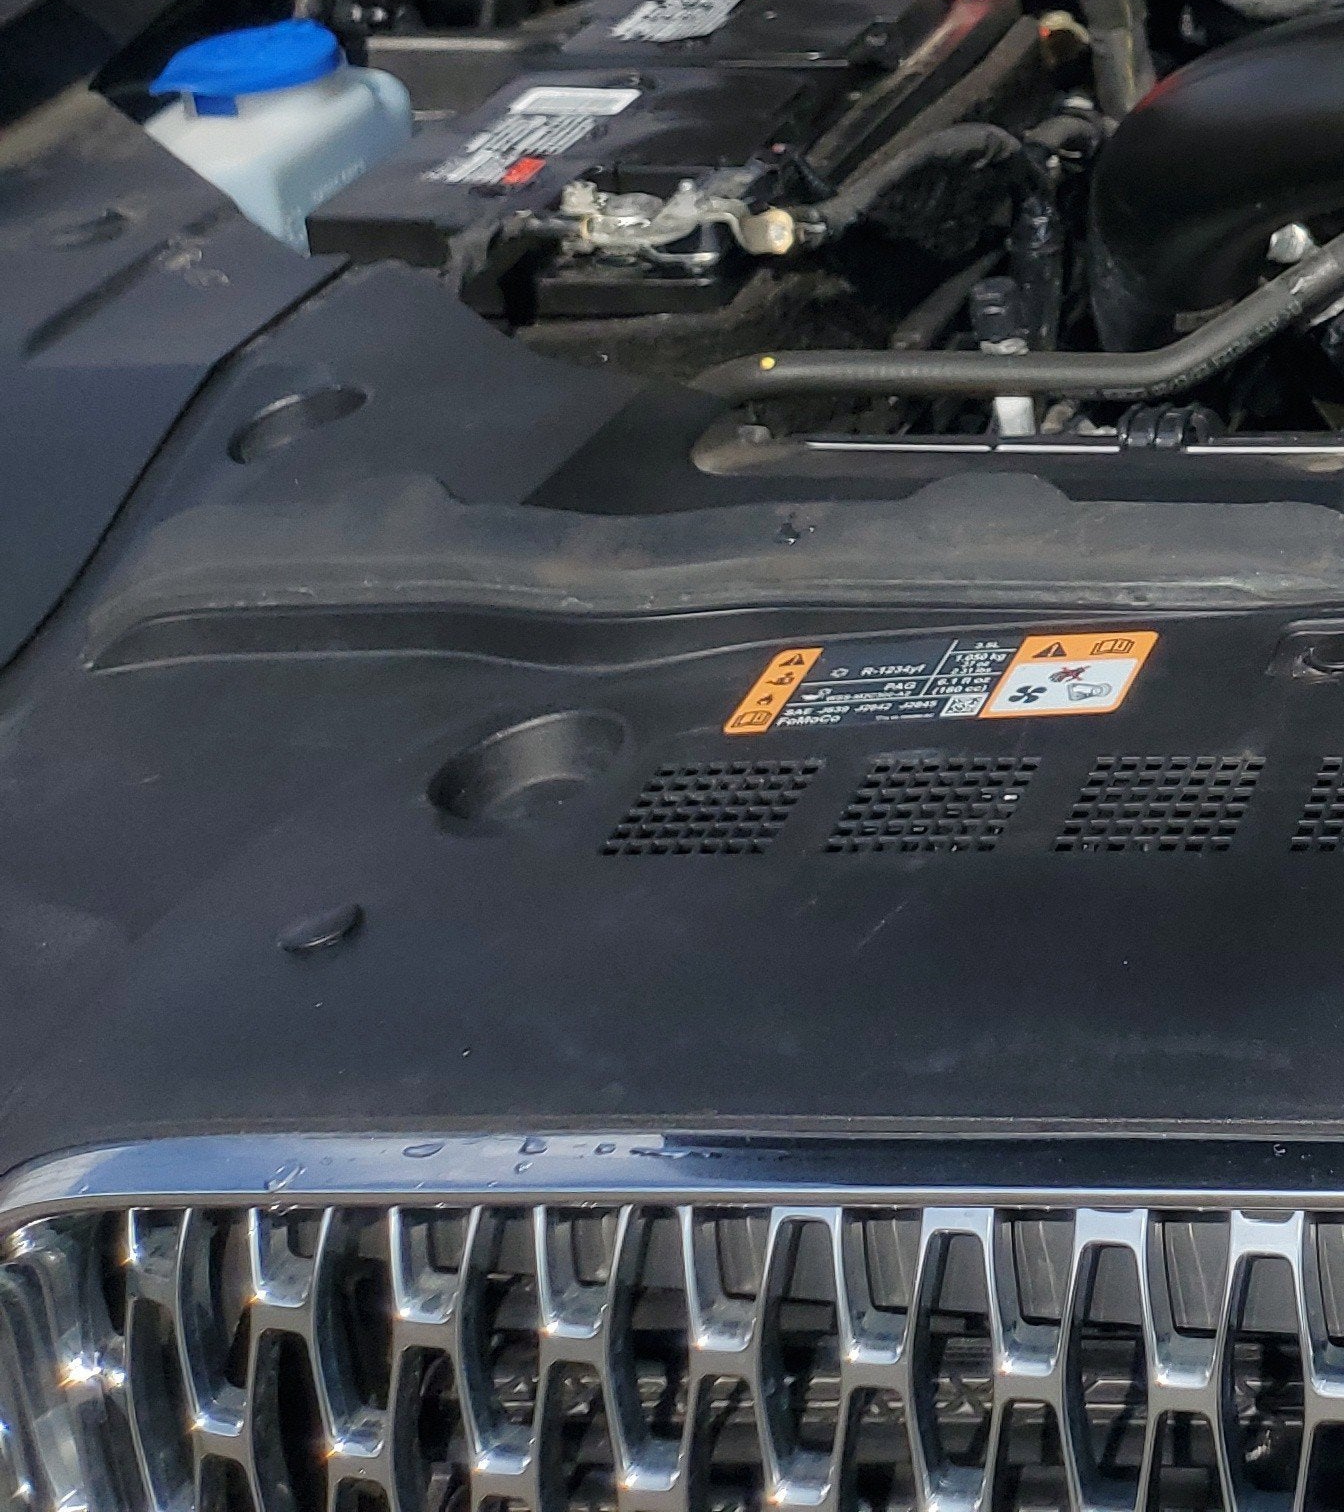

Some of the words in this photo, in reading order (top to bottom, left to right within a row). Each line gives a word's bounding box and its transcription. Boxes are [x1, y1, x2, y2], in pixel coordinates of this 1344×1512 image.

[860, 663, 927, 677] R-1234yf
[883, 681, 917, 691] PAG
[784, 707, 814, 716] SAE
[776, 714, 842, 727] FoMoCo
